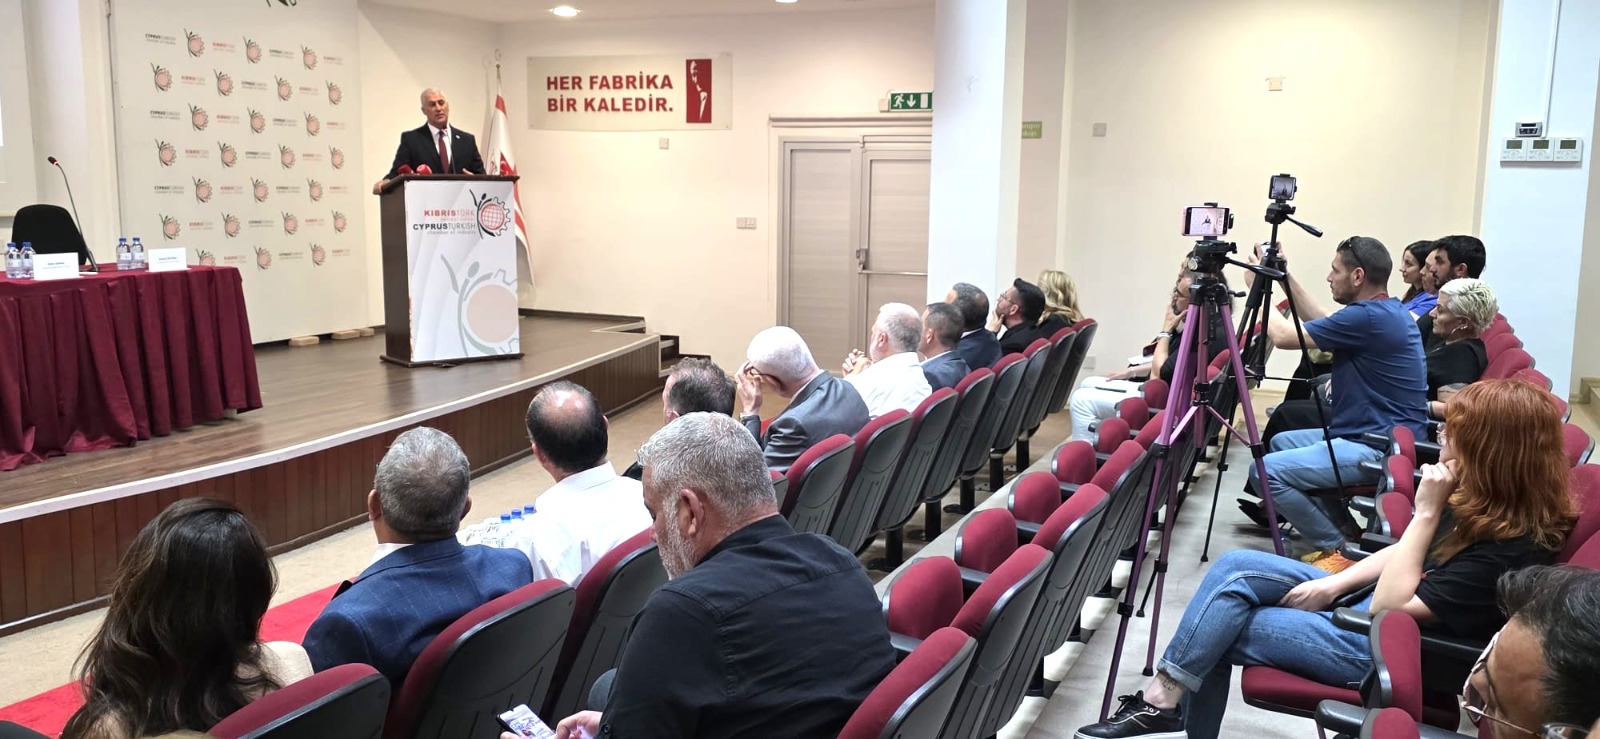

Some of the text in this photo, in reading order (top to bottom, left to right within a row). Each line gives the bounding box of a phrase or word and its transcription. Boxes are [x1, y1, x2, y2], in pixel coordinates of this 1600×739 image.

[546, 71, 673, 91] HER FABRİKA
[547, 93, 673, 112] BİR KALEDİR.
